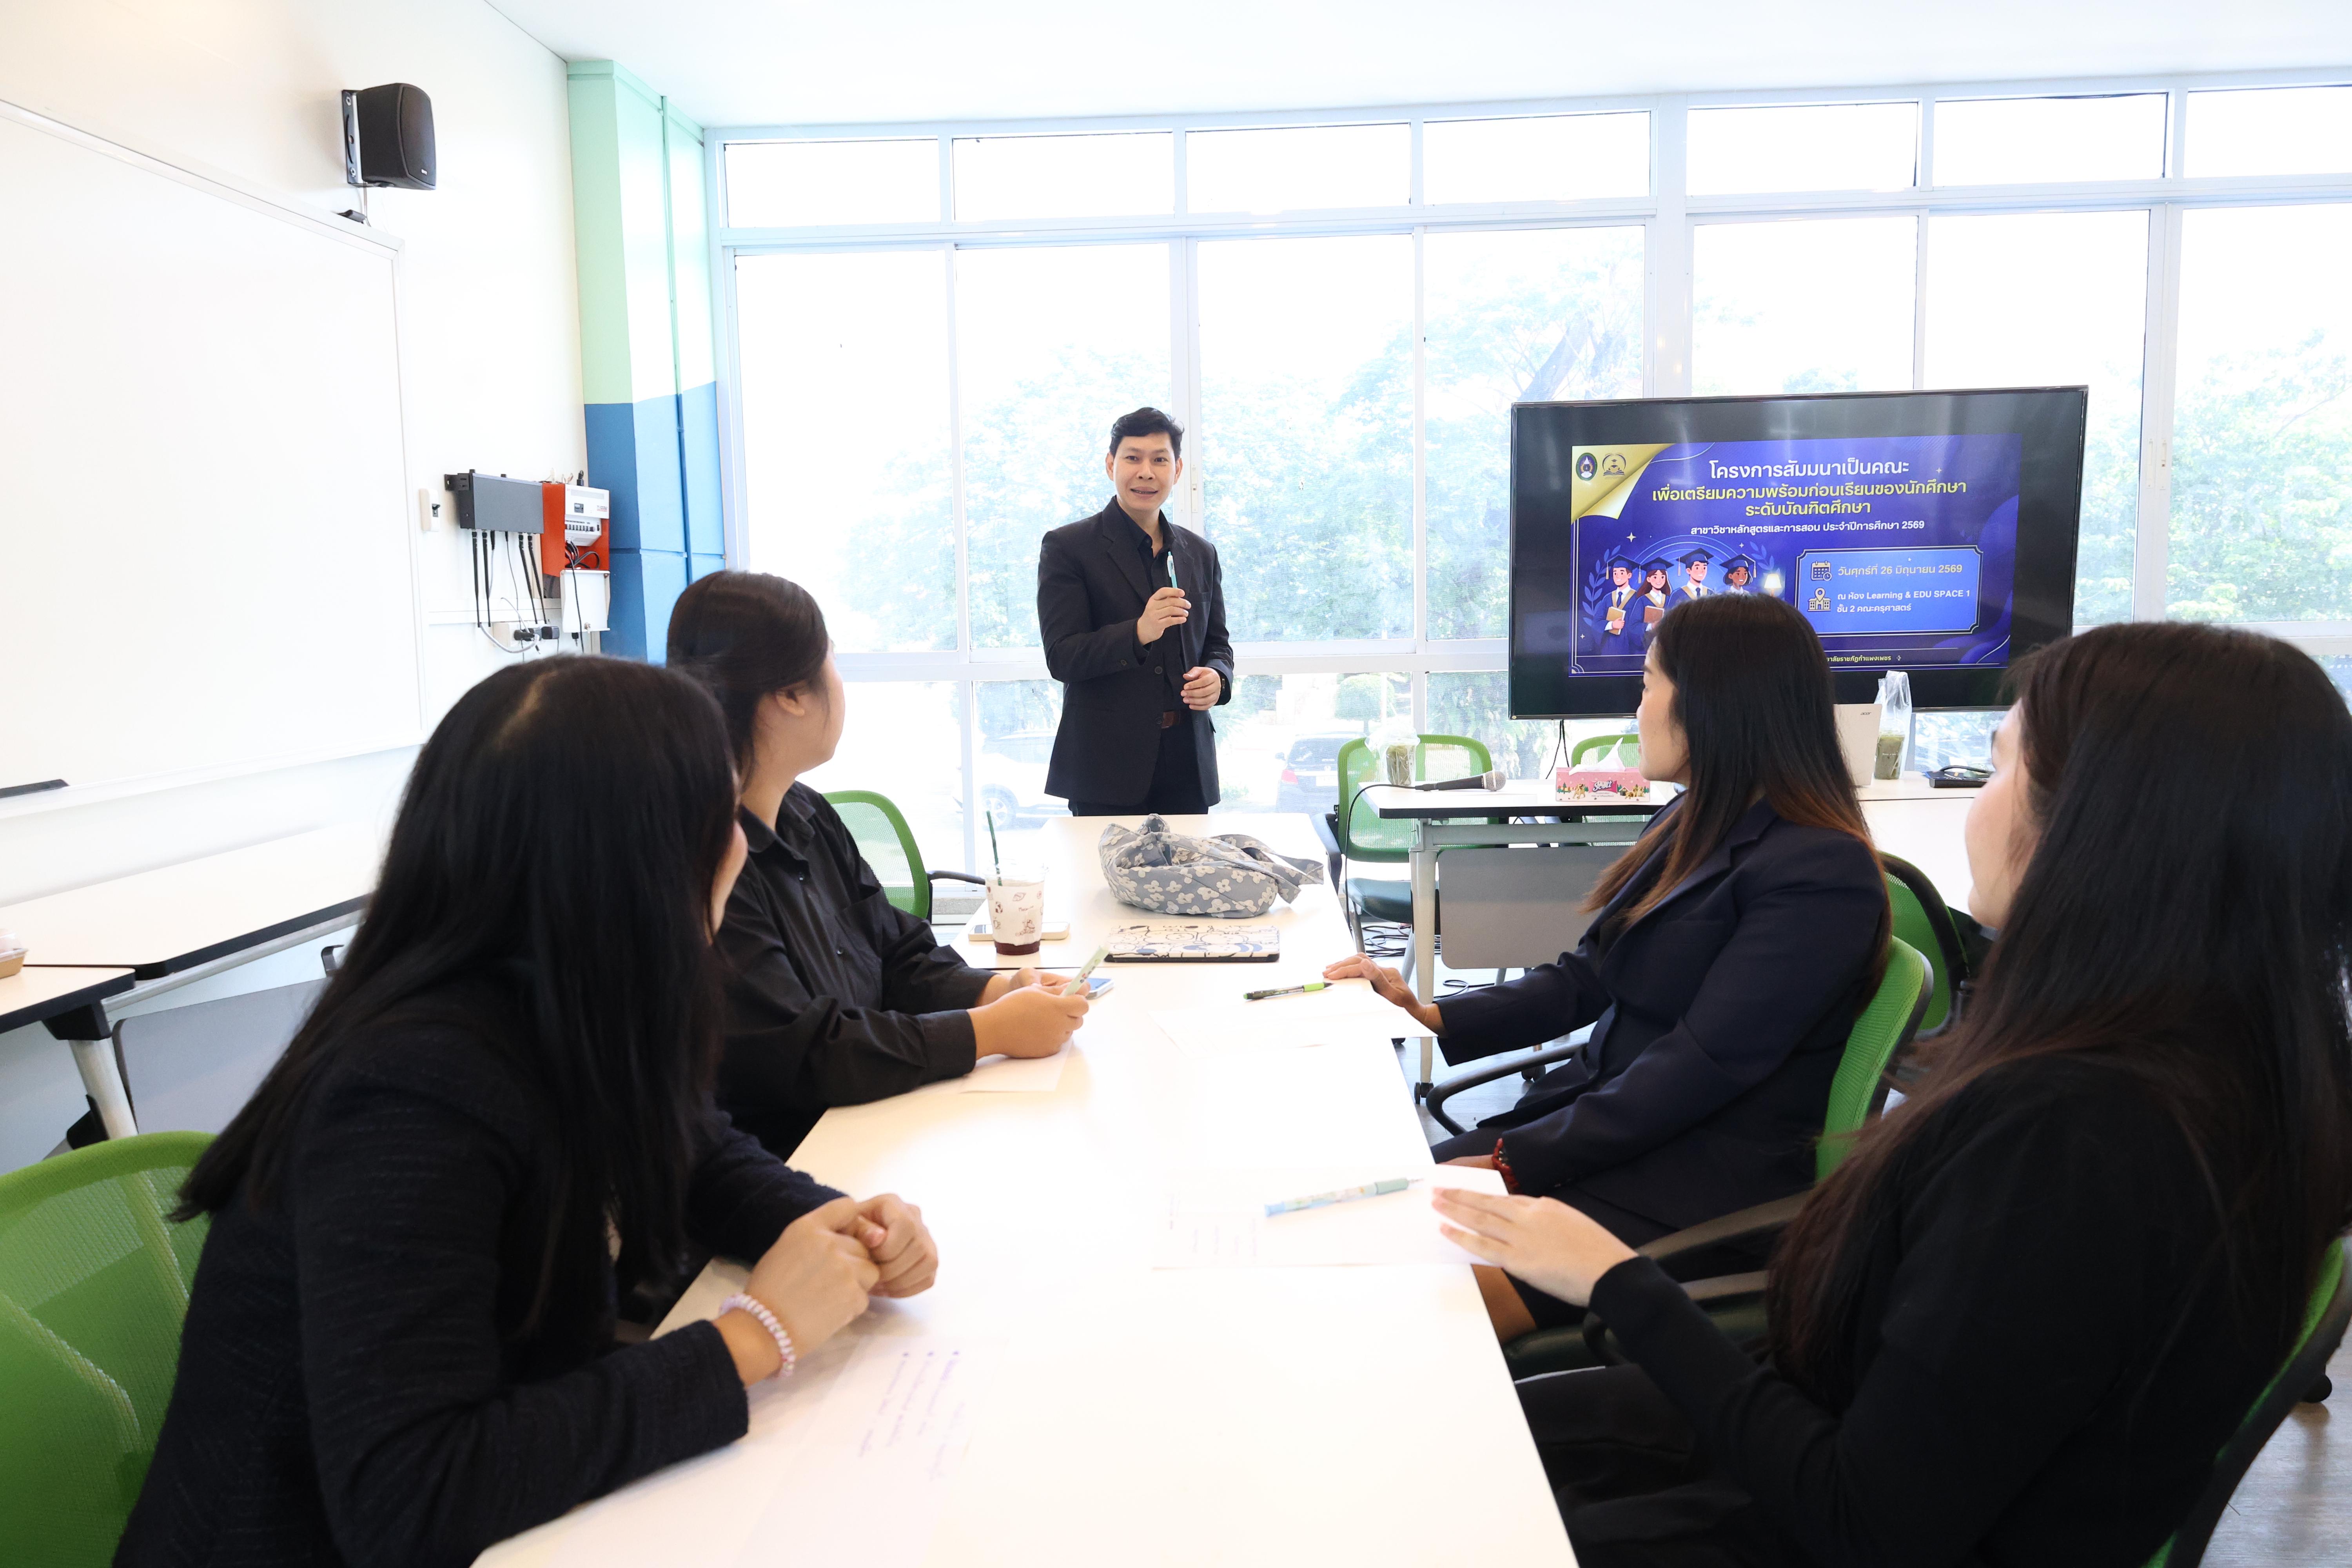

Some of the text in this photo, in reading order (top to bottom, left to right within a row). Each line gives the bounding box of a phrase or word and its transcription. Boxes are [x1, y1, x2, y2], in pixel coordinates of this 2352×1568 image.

[1709, 457, 1909, 479] โครงการสัมมนาเป็นคณะ
[1653, 479, 1966, 501] เพื่อเตรียมความพร้อมก่อนเรียนของนักศึกษา
[1746, 499, 1871, 516] ระดับบัณฑิตศึกษา
[1691, 520, 1925, 535] สาขาวิชาหลักสูตรและการสอน ประจำปีการศึกษา 2569
[1838, 564, 1962, 577] วันศุกร์ที่ 26 มิถุนายน 2569
[1866, 591, 1902, 600] Learning
[1837, 604, 1848, 613] ชั้น
[1857, 603, 1912, 613] คณะครุศาสตร์
[1592, 780, 1613, 792] Scott
